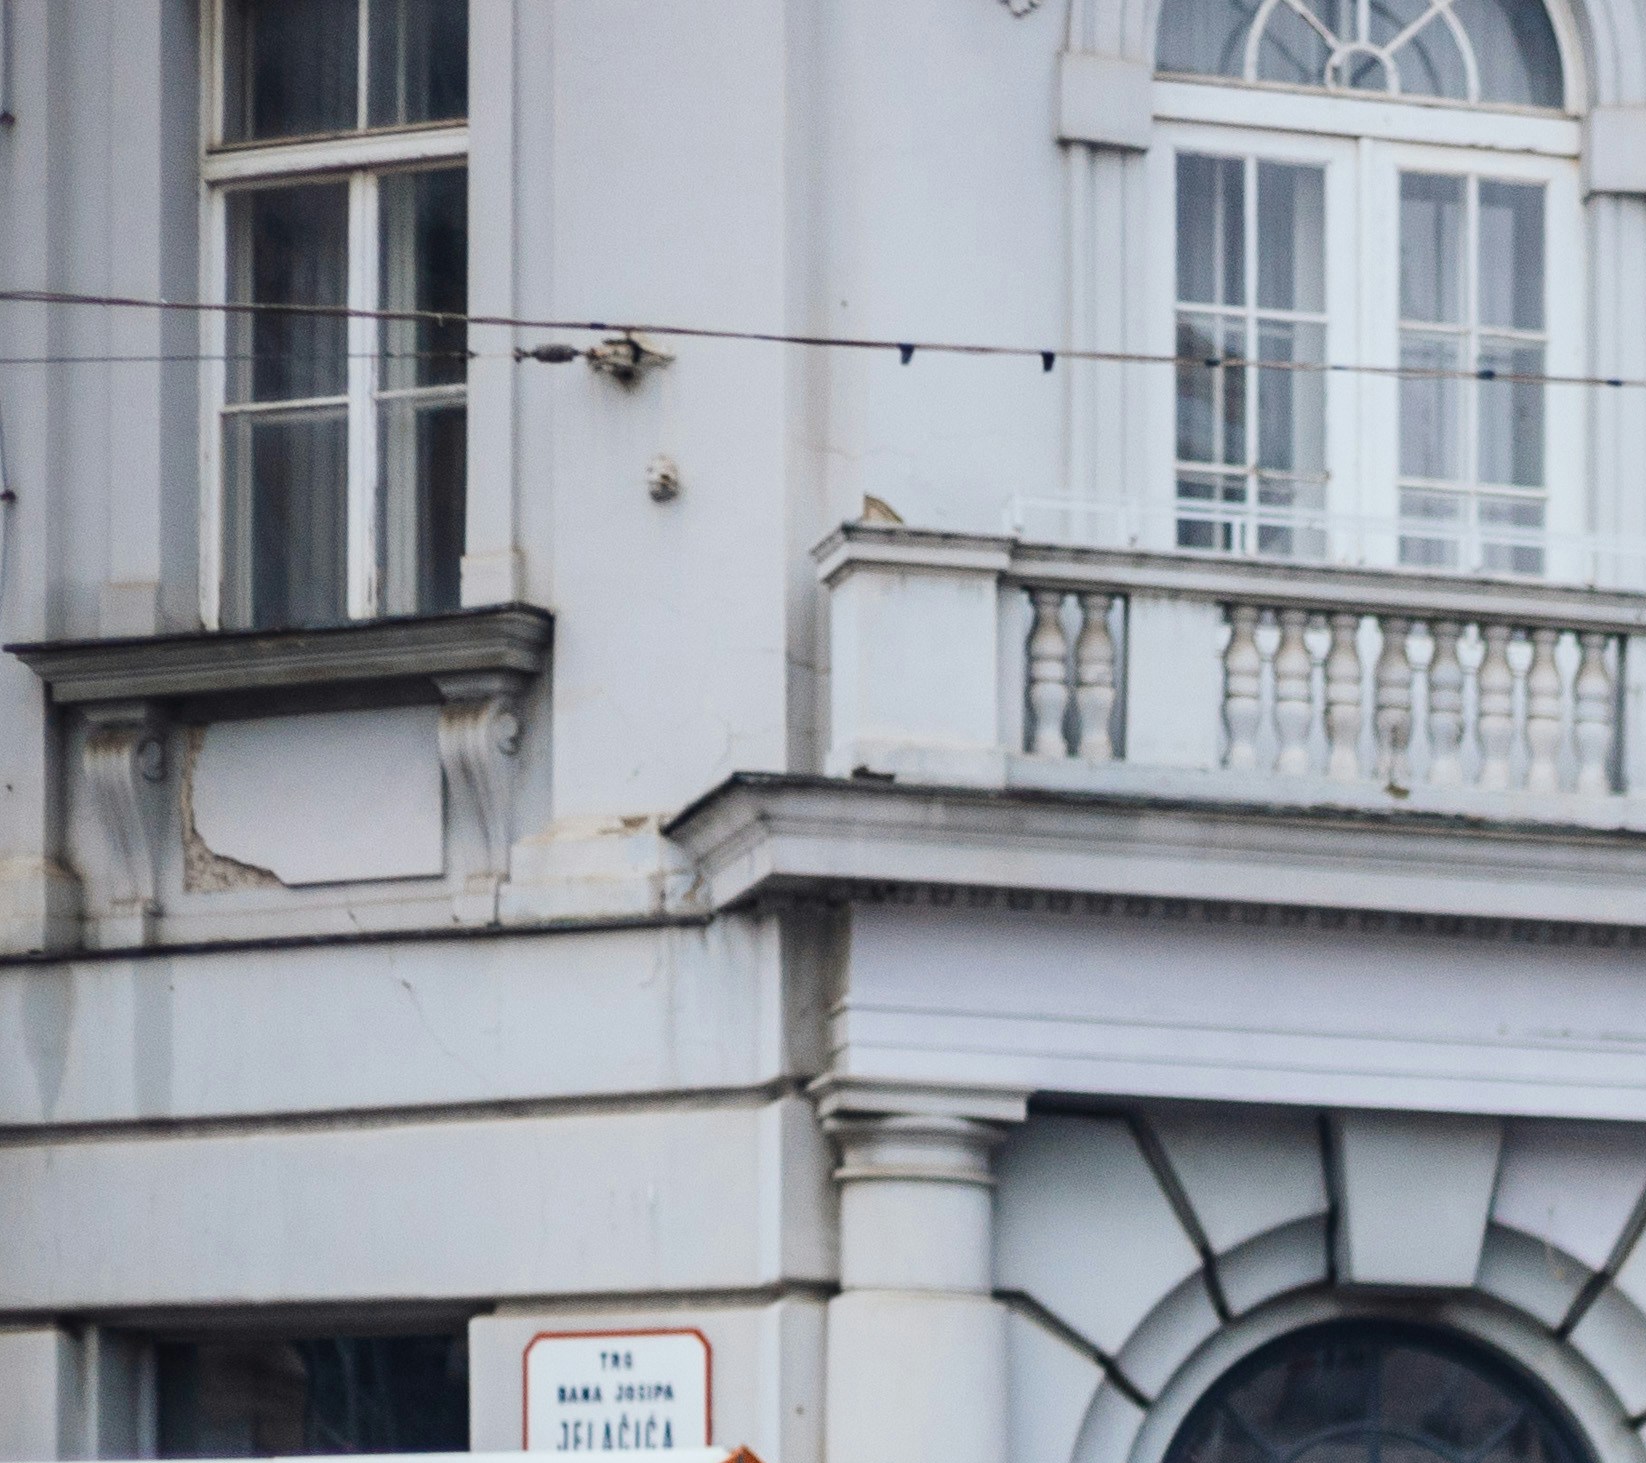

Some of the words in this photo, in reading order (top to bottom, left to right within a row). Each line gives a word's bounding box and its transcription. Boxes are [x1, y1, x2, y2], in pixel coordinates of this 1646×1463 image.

[600, 1351, 633, 1370] TRG
[558, 1385, 602, 1402] BANA
[616, 1383, 674, 1402] JOSIPA
